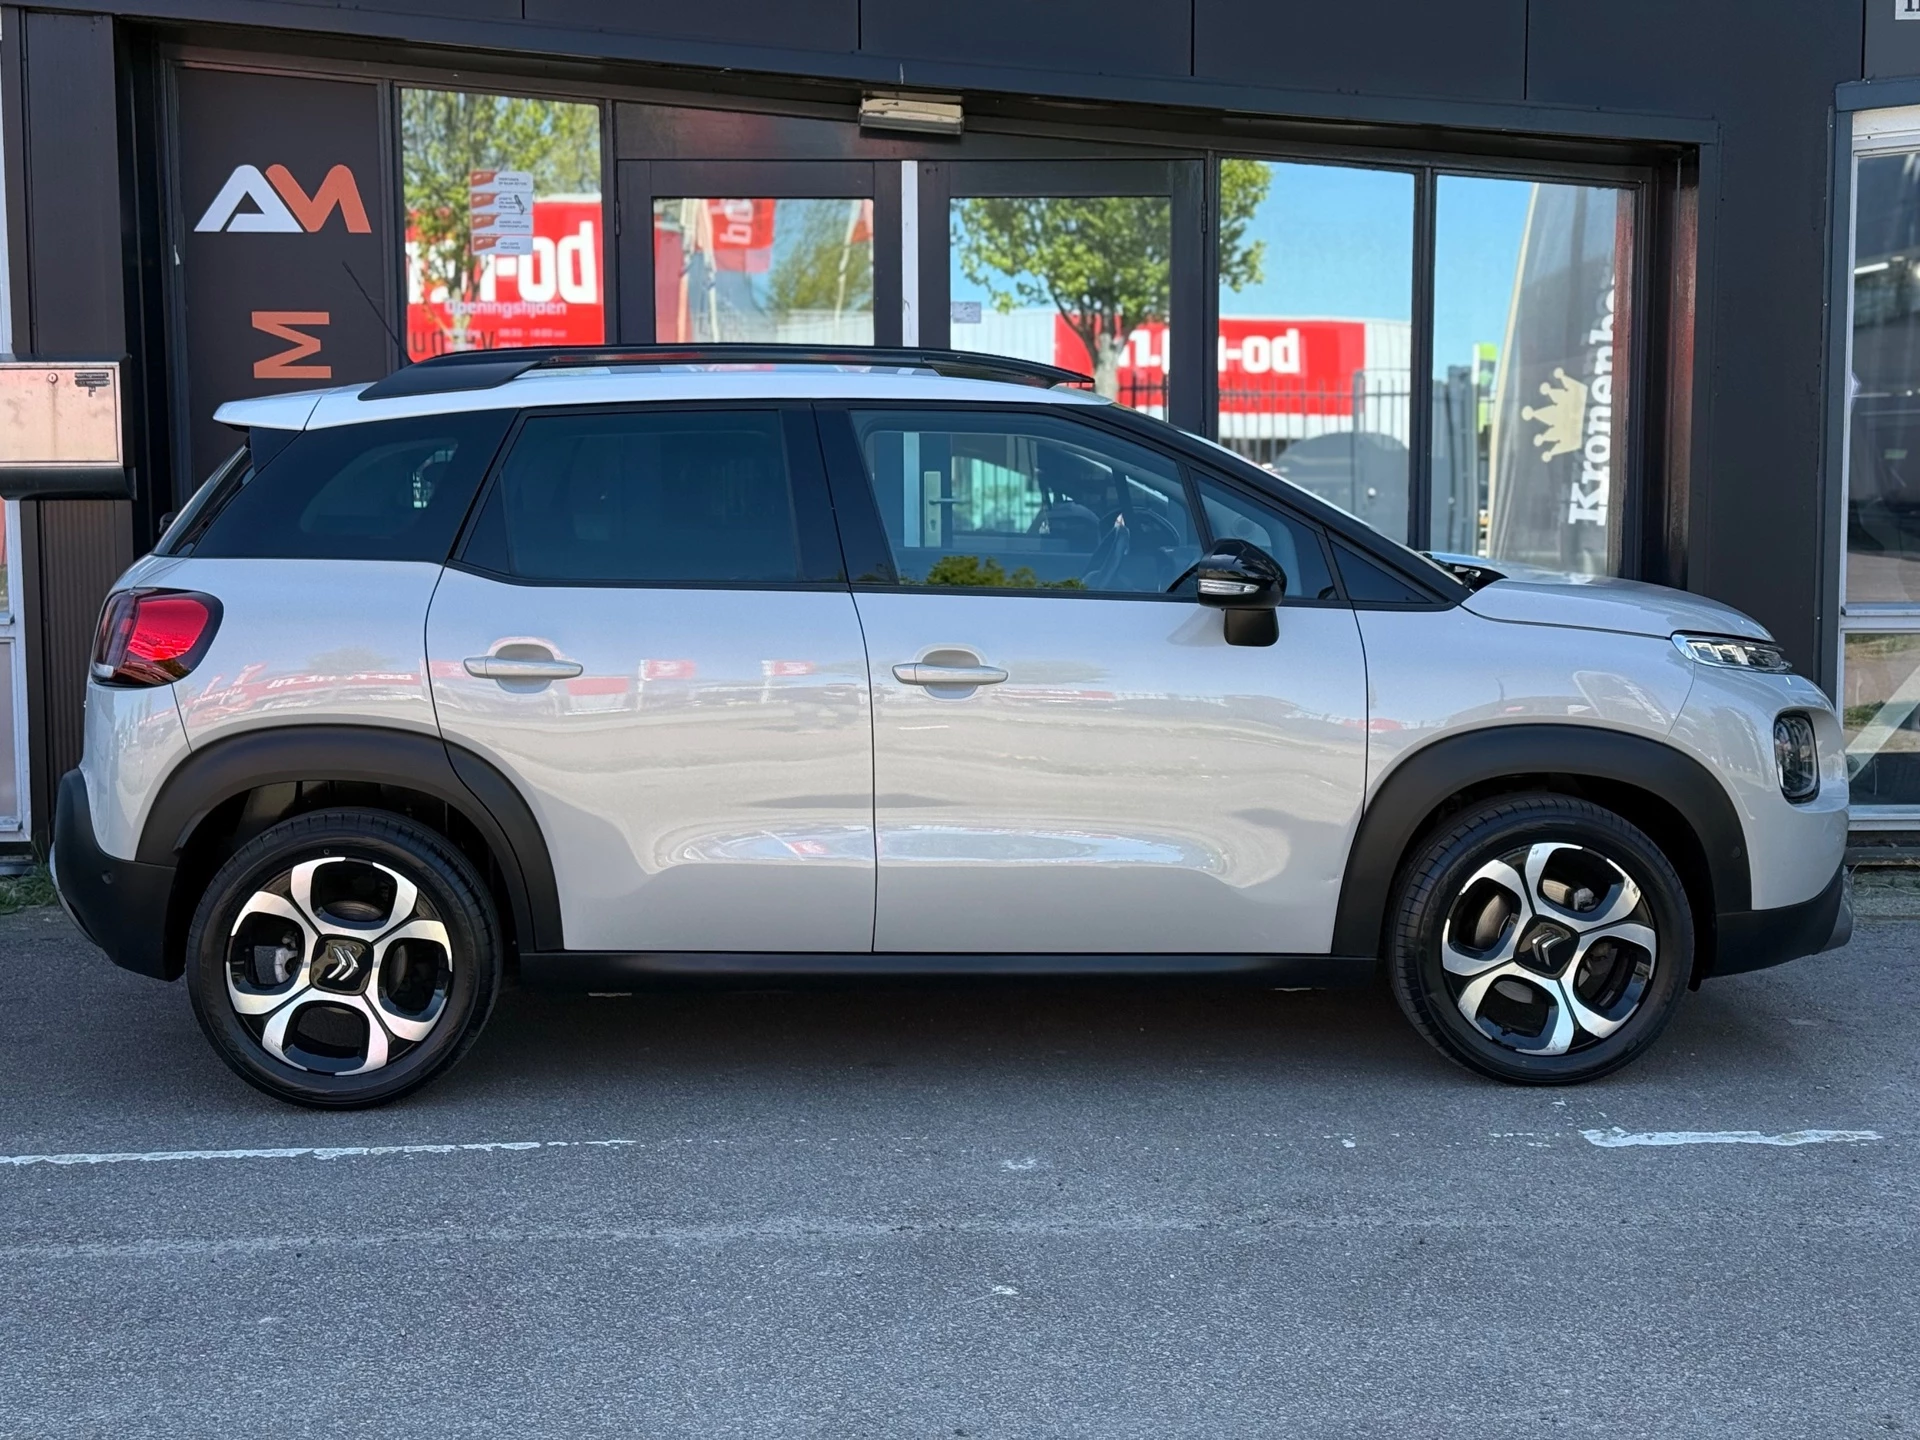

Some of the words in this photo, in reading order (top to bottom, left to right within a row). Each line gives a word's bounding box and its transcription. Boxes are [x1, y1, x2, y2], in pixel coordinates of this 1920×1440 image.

[193, 163, 372, 234] AM
[444, 298, 567, 319] Openingstijden
[1568, 274, 1615, 526] Kronenb
